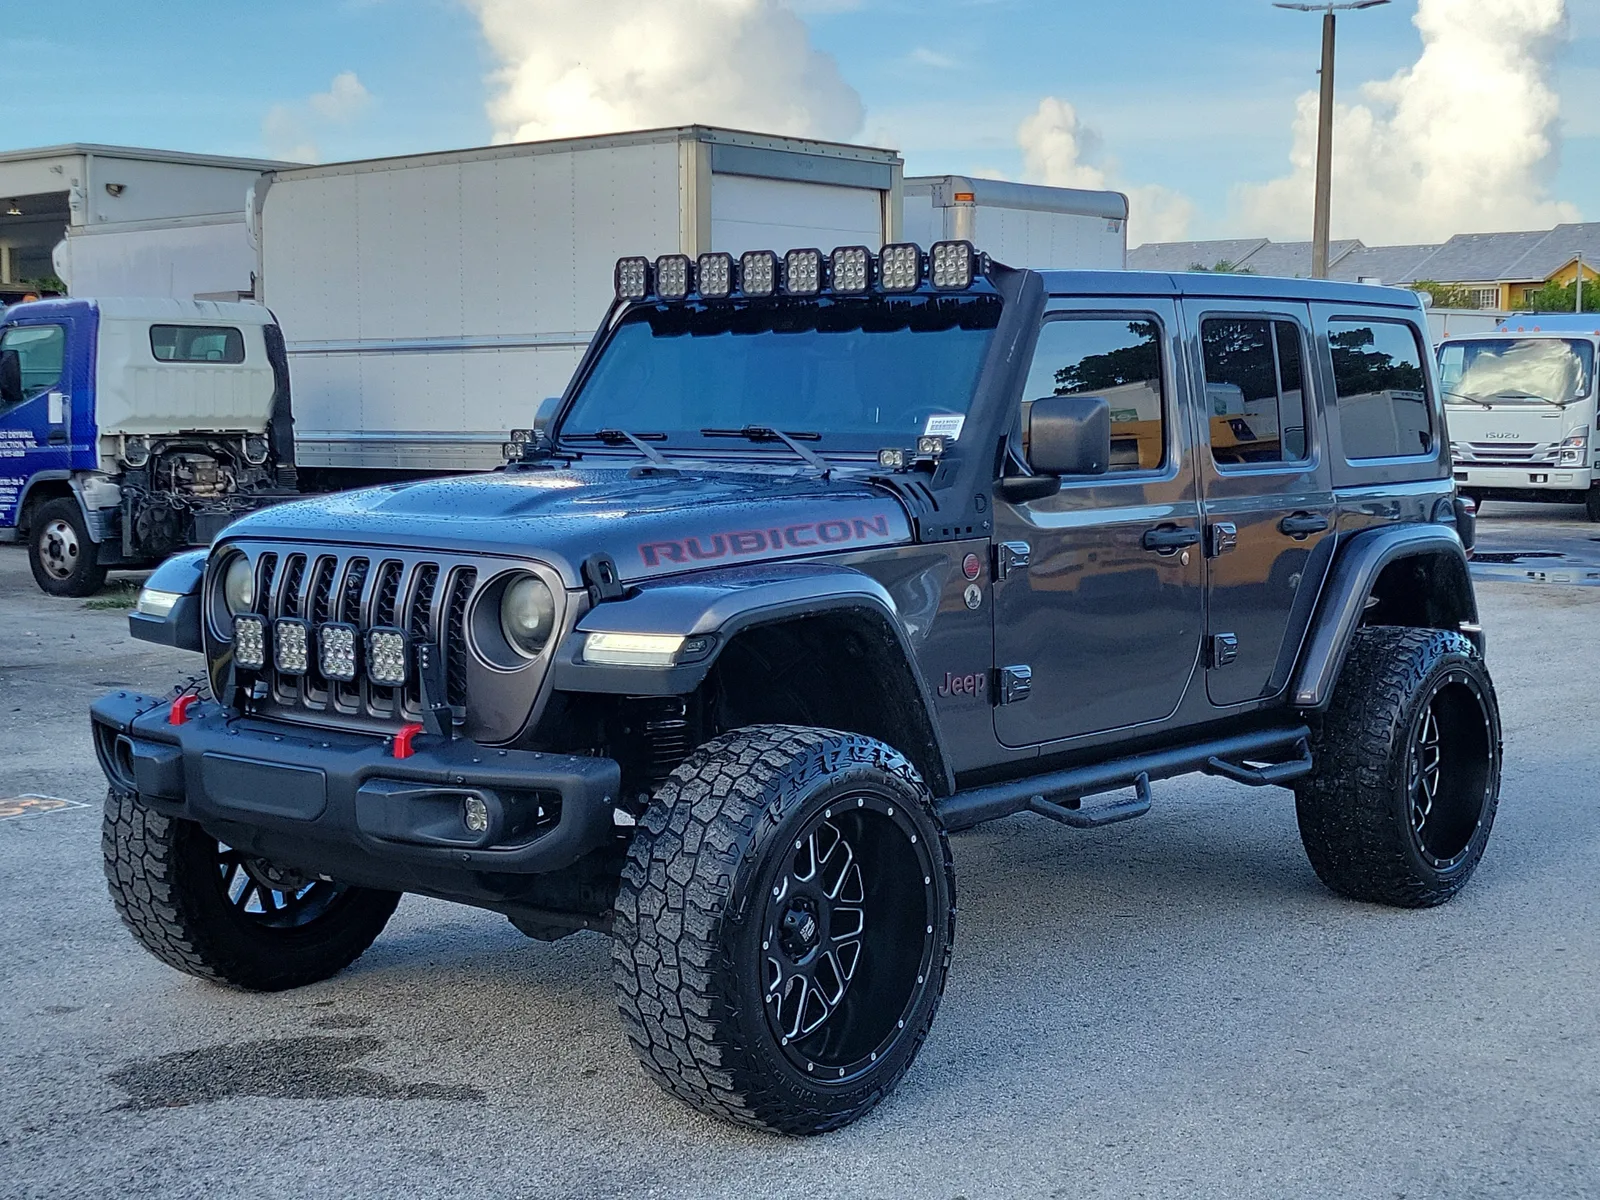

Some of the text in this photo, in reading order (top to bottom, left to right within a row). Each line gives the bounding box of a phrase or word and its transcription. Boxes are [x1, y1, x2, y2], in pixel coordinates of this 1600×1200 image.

[1485, 431, 1520, 439] ISUZU
[638, 514, 889, 567] RUBICON
[938, 672, 987, 698] Jeep
